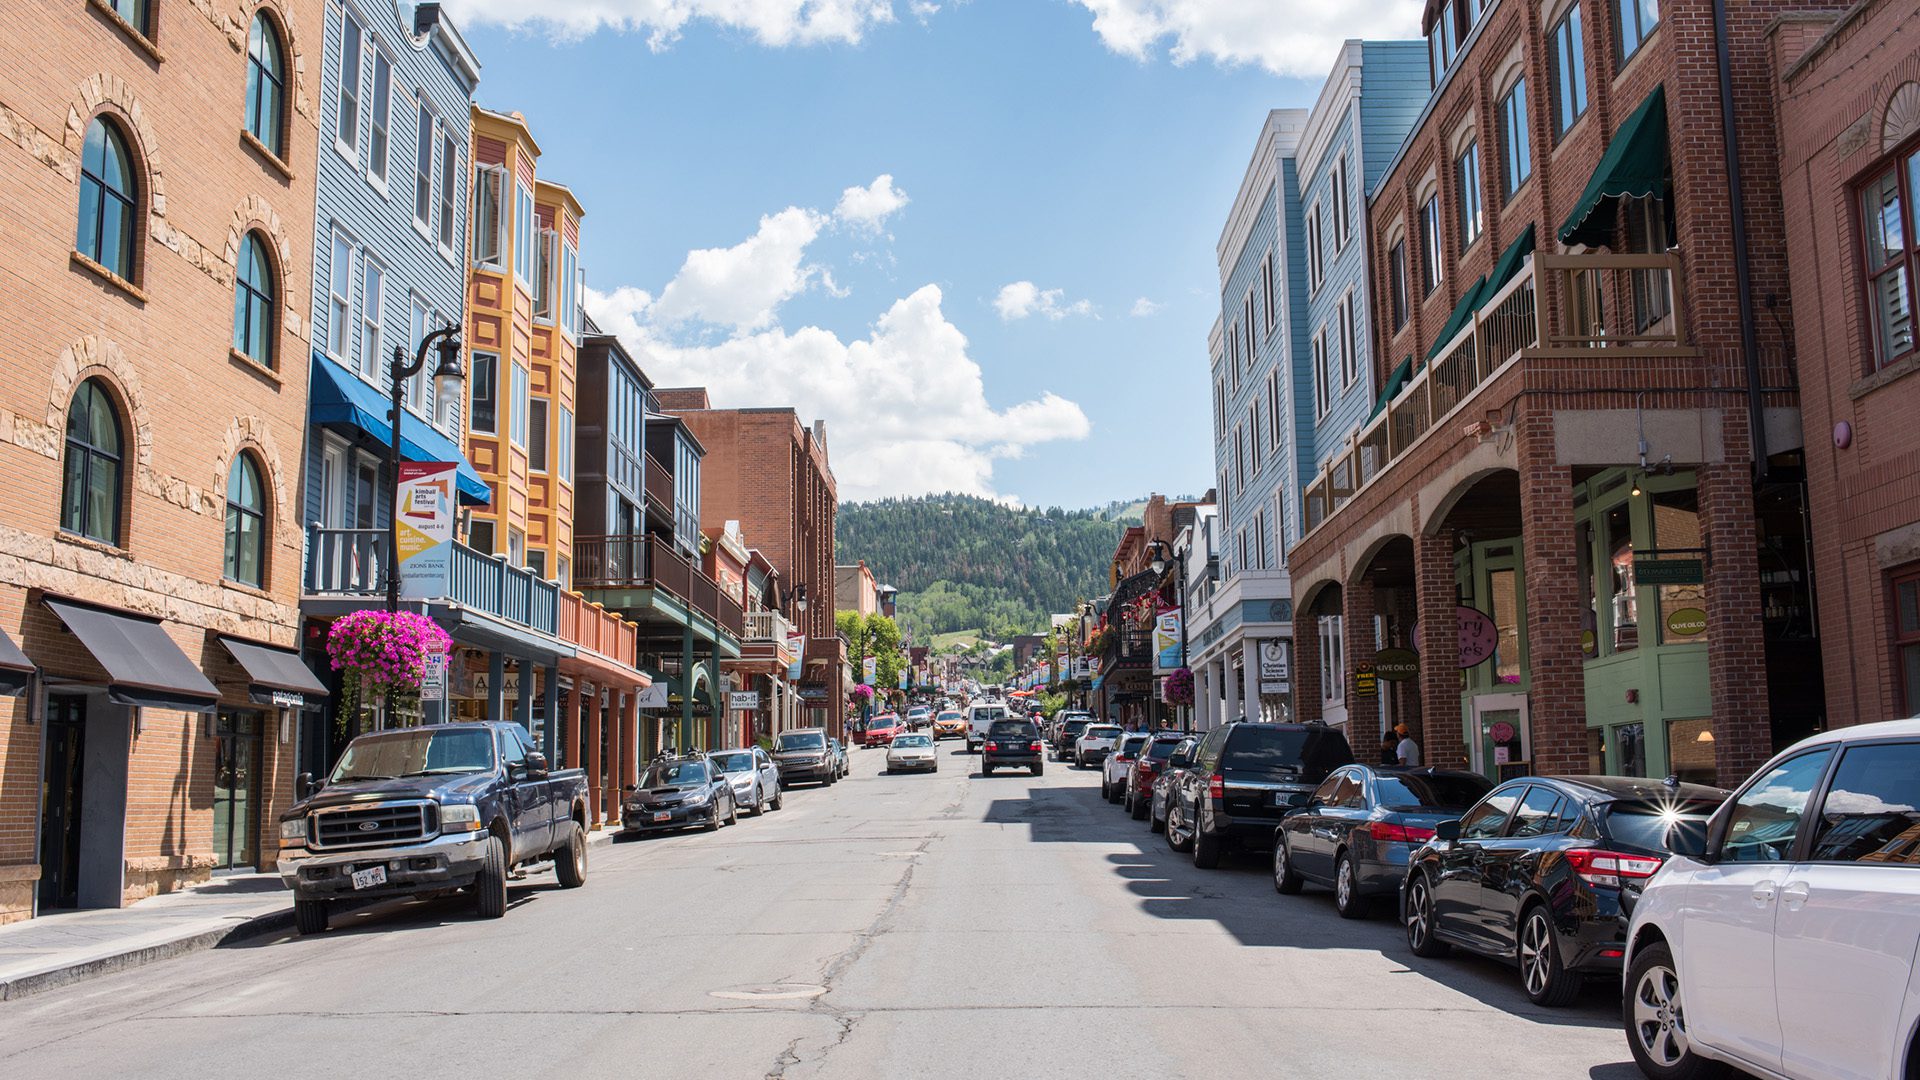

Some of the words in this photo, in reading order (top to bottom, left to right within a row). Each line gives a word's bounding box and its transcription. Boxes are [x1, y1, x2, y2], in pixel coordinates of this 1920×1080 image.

[400, 536, 426, 544] cuisine.
[1671, 622, 1686, 630] OLIVE
[272, 691, 304, 707] patagonia
[356, 876, 368, 886] 152
